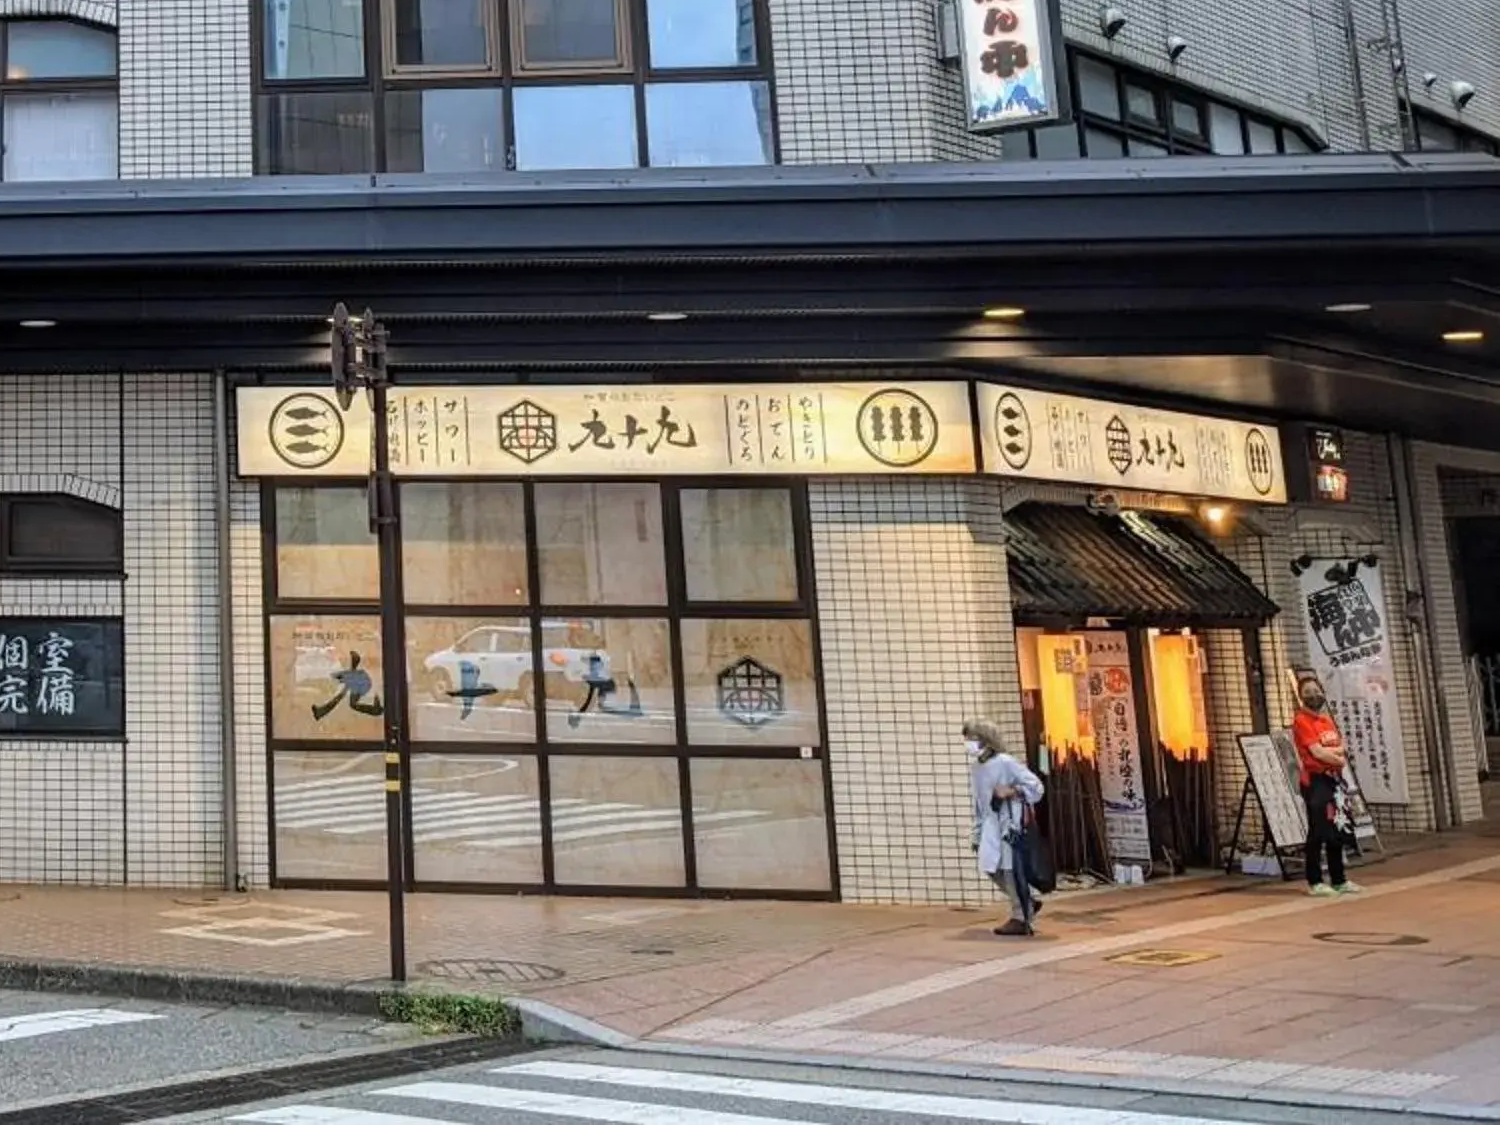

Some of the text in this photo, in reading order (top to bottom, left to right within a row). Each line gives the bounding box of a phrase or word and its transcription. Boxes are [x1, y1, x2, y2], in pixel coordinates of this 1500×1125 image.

[442, 399, 460, 463] サワー
[567, 404, 698, 455] 九十九
[767, 397, 785, 461] おでん
[1136, 427, 1186, 472] 九十九
